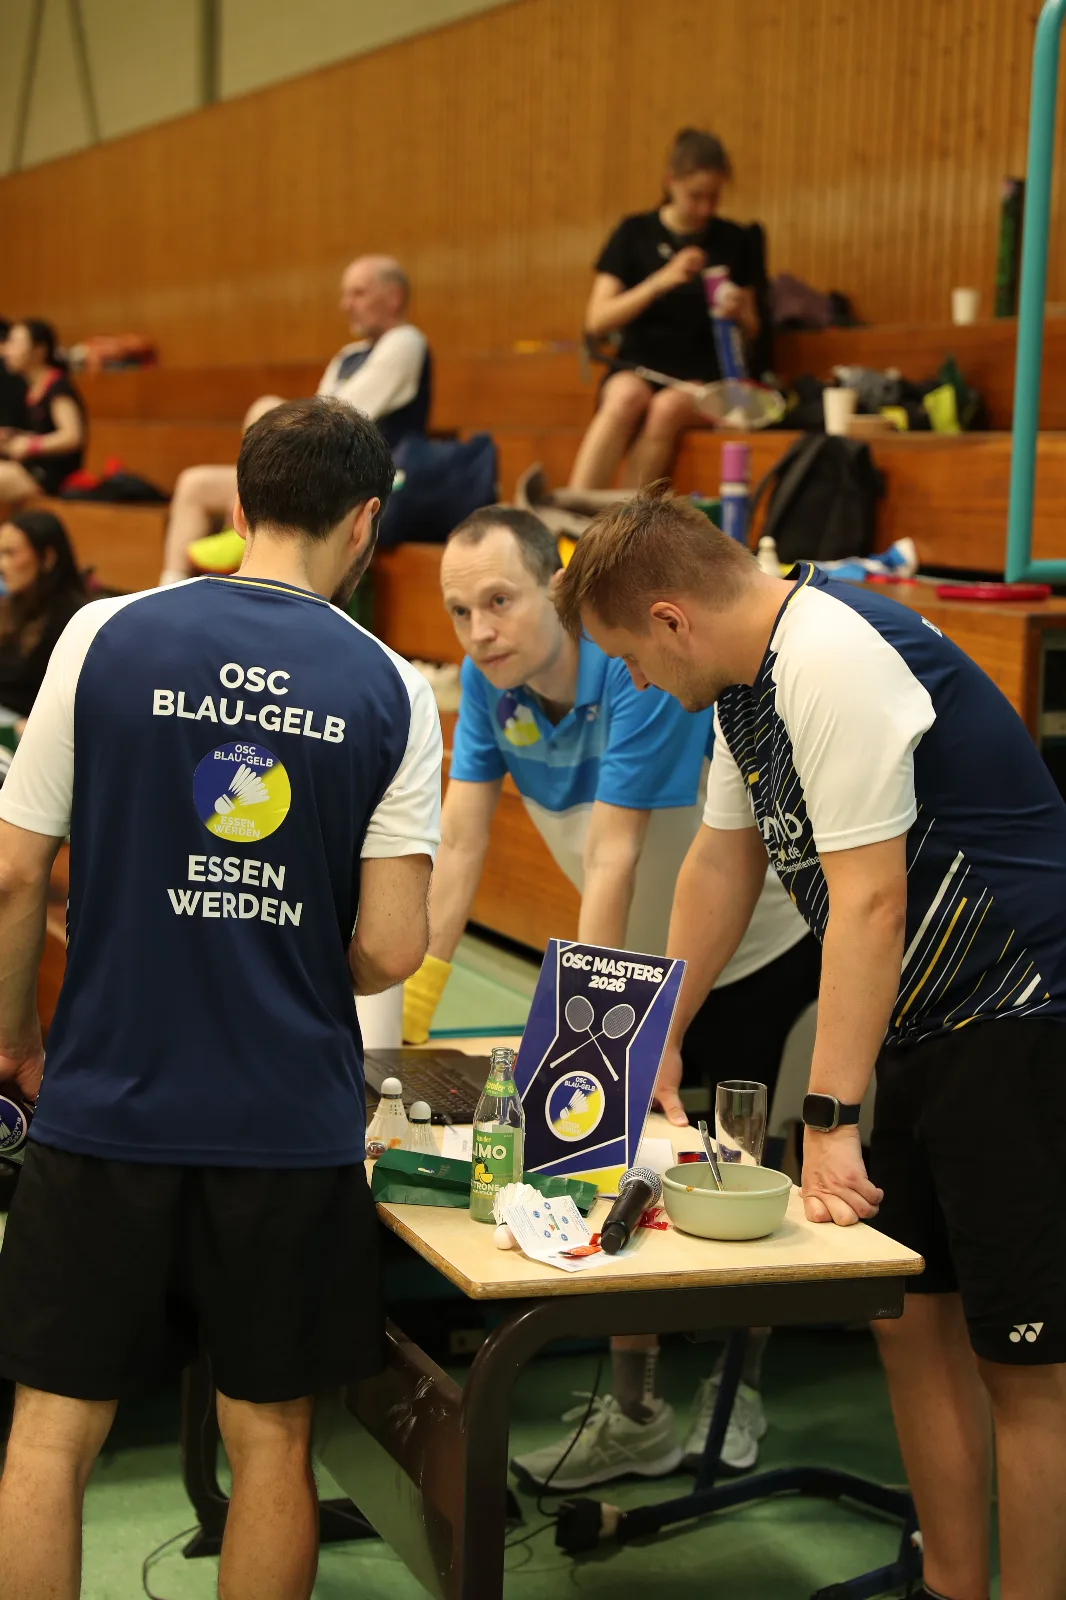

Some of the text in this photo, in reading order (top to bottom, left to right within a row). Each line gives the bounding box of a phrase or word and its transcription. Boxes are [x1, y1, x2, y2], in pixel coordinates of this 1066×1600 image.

[219, 662, 291, 695] OSC
[152, 689, 346, 743] BLAU-GELB
[235, 744, 256, 755] OSC
[213, 751, 274, 768] BLAU-GELB
[213, 824, 260, 838] WERDEN
[220, 816, 255, 829] ESSEN
[188, 854, 286, 891] ESSEN
[167, 888, 303, 927] WERDEN
[561, 952, 664, 984] OSC MASTERS
[588, 975, 627, 993] 2026
[564, 1080, 596, 1092] BLAU-GELB
[575, 1076, 587, 1084] OSC
